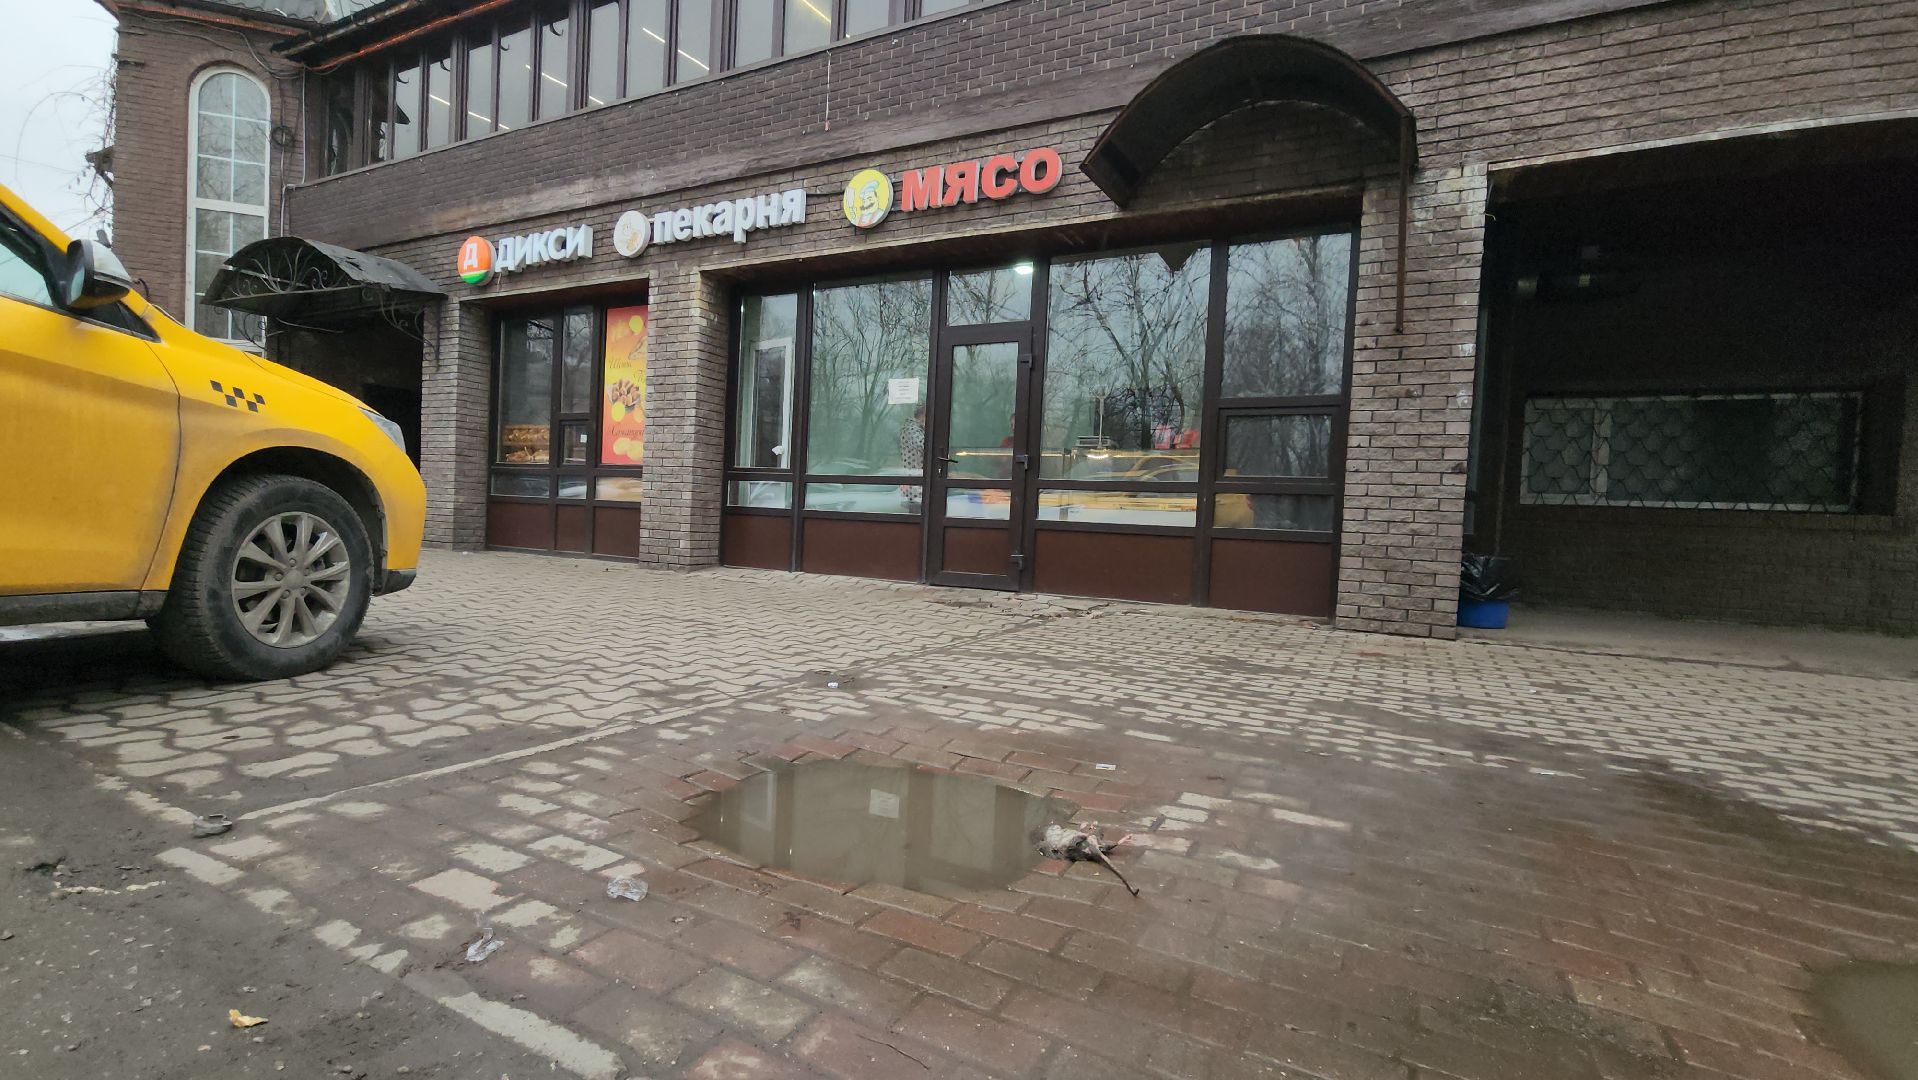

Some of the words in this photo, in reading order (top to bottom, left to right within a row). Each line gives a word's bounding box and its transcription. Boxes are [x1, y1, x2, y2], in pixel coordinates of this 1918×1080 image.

[902, 148, 1062, 211] МЯСО
[654, 189, 806, 243] пекарня
[463, 243, 478, 270] Д
[495, 223, 594, 273] ДИКСИ
